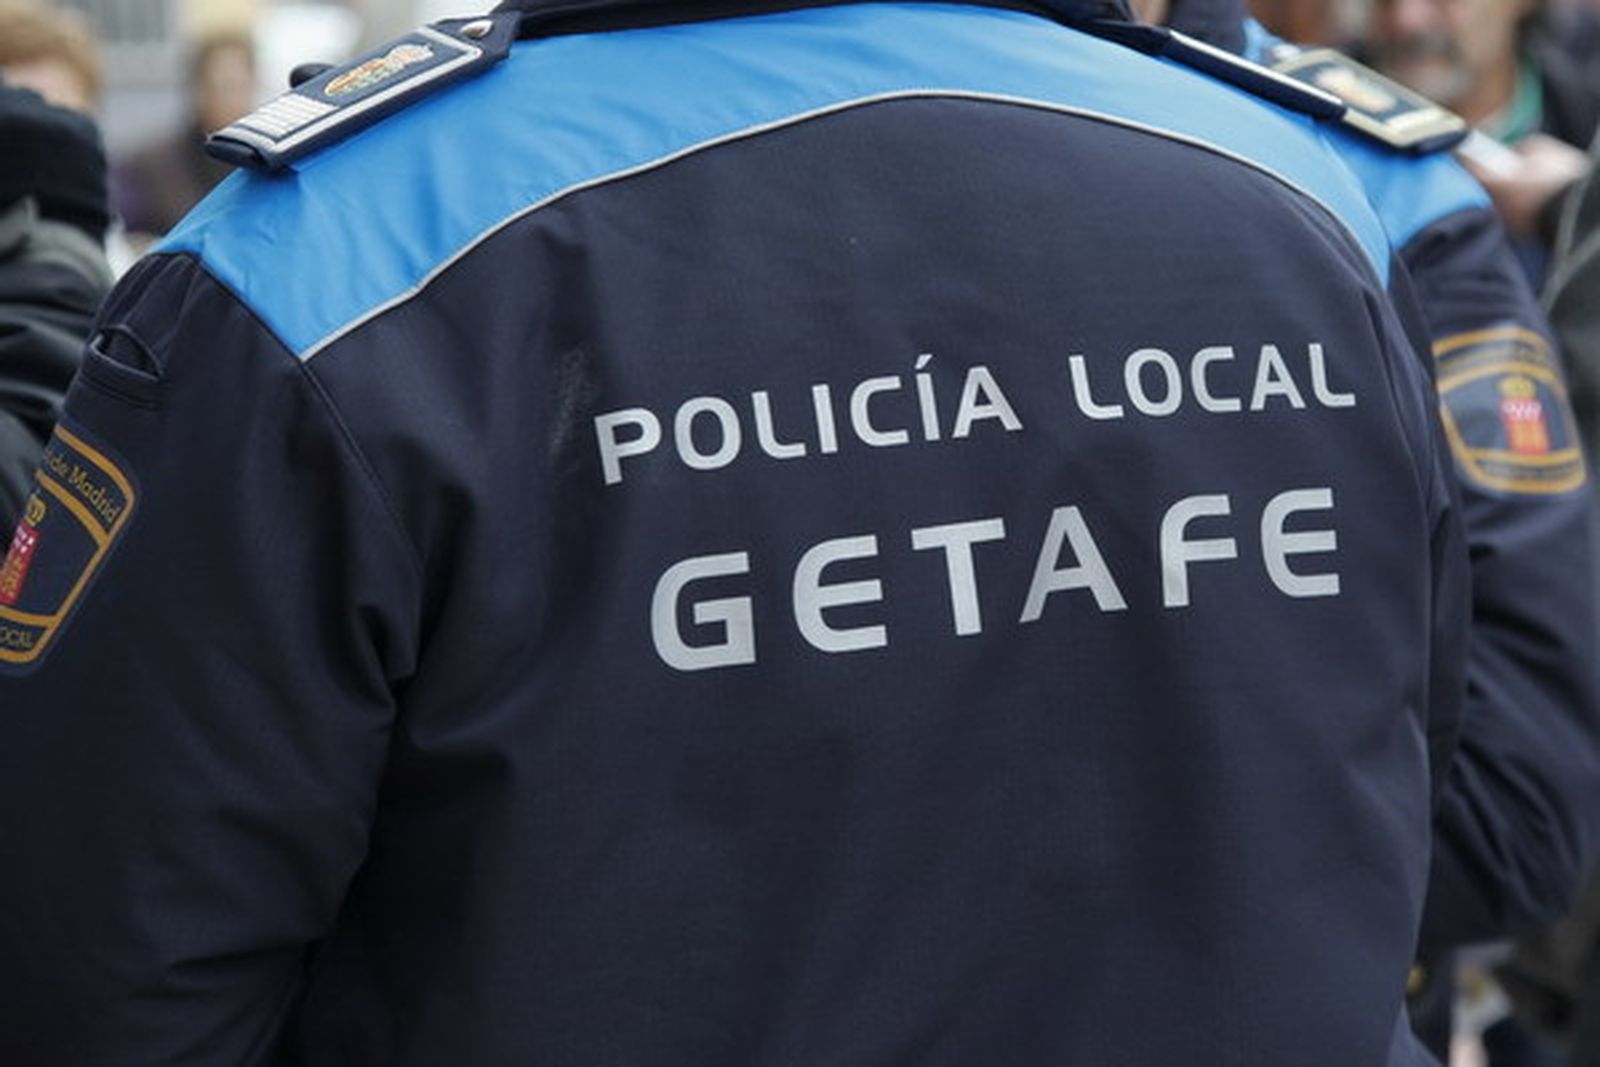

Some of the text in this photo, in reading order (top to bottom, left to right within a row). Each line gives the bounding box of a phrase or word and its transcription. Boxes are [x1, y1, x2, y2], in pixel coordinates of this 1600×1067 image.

[594, 342, 1356, 485] POLICÍA LOCAL
[68, 464, 122, 523] Madrid
[651, 487, 1341, 671] GETAFE
